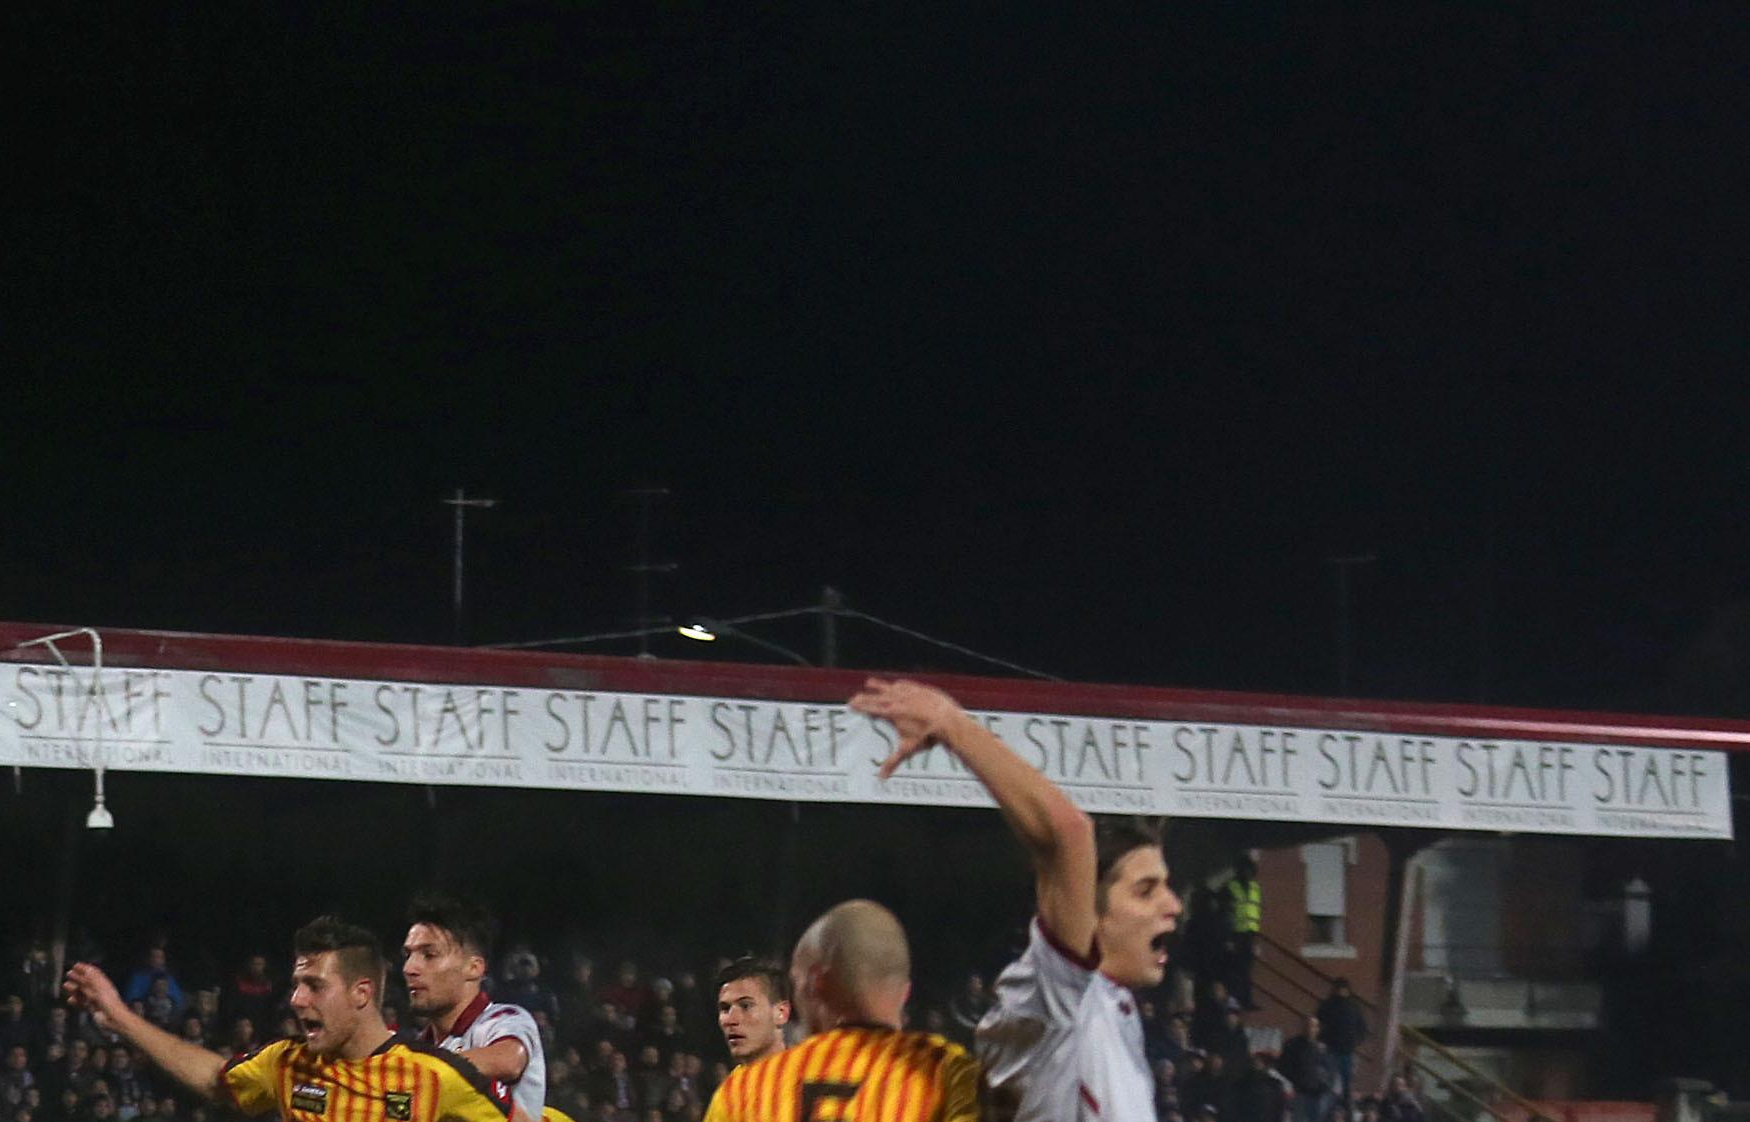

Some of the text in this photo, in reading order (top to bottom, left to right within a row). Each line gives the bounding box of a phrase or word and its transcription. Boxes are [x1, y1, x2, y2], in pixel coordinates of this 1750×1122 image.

[15, 666, 172, 735] STAFF
[198, 674, 347, 744] STAFF
[375, 685, 521, 752] STAFF
[545, 693, 686, 759] STAFF
[711, 702, 847, 766] STAFF
[1024, 718, 1150, 781] STAFF
[1174, 726, 1297, 787] STAFF
[1317, 734, 1436, 794] STAFF
[1457, 742, 1573, 801] STAFF
[1593, 749, 1707, 807] STAFF
